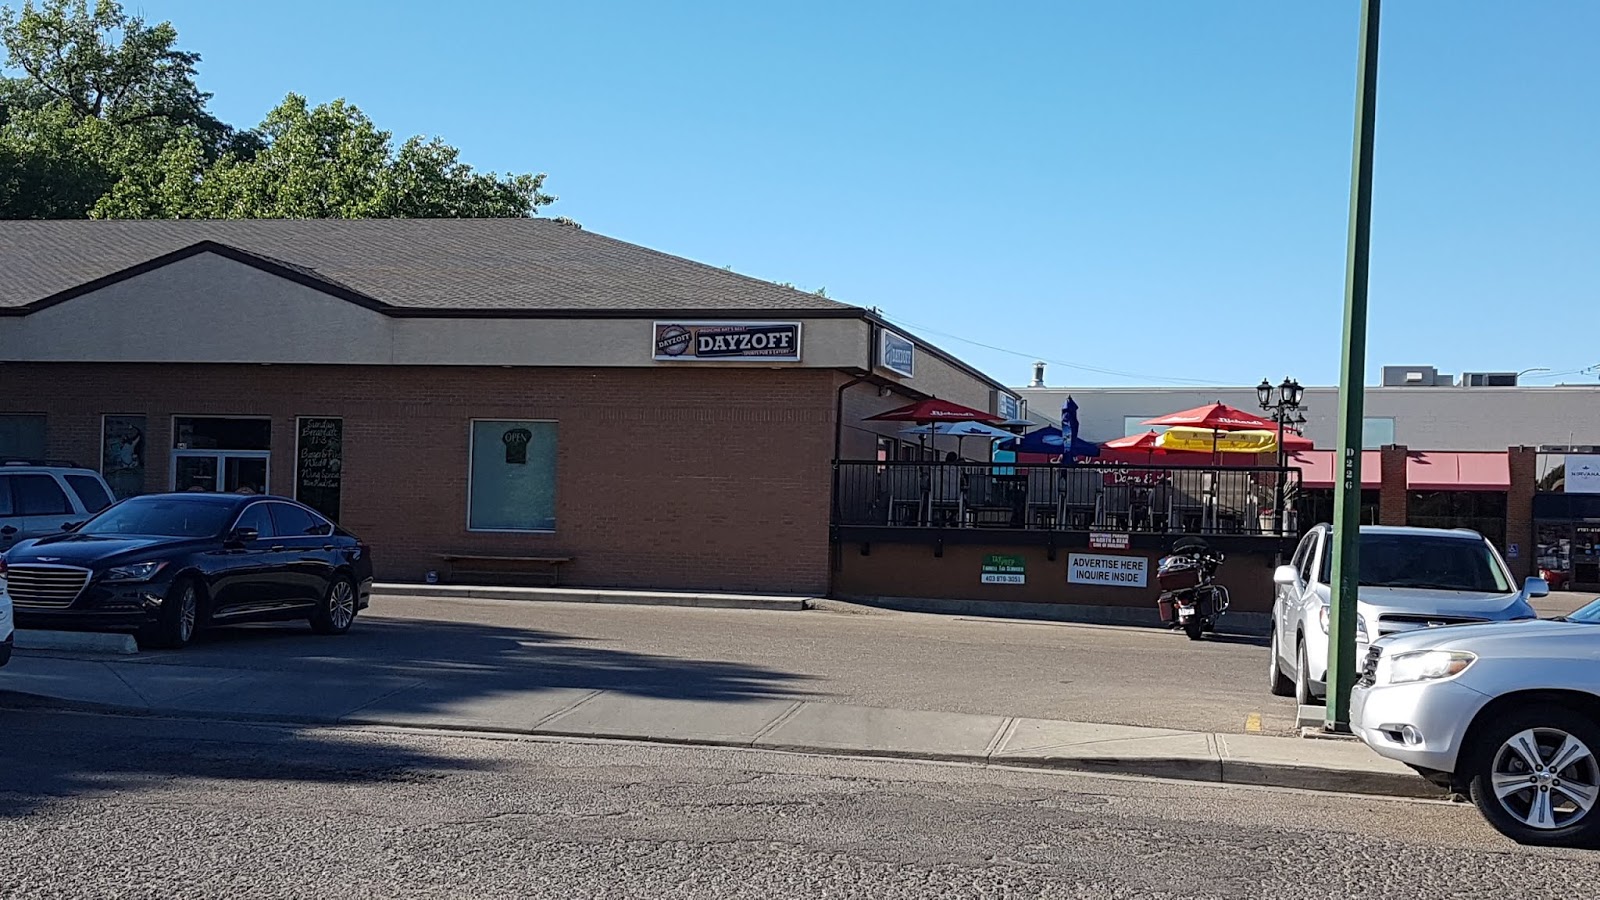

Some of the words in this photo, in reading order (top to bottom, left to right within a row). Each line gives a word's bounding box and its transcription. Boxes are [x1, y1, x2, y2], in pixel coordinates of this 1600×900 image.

[658, 333, 690, 348] DAYZOFF
[698, 332, 792, 351] DAYZOFF
[504, 432, 529, 442] OPEN
[1073, 558, 1119, 569] ADVERTISE
[1120, 560, 1143, 571] HERE
[1076, 569, 1110, 581] INQUIRE
[1111, 572, 1139, 583] INSIDE
